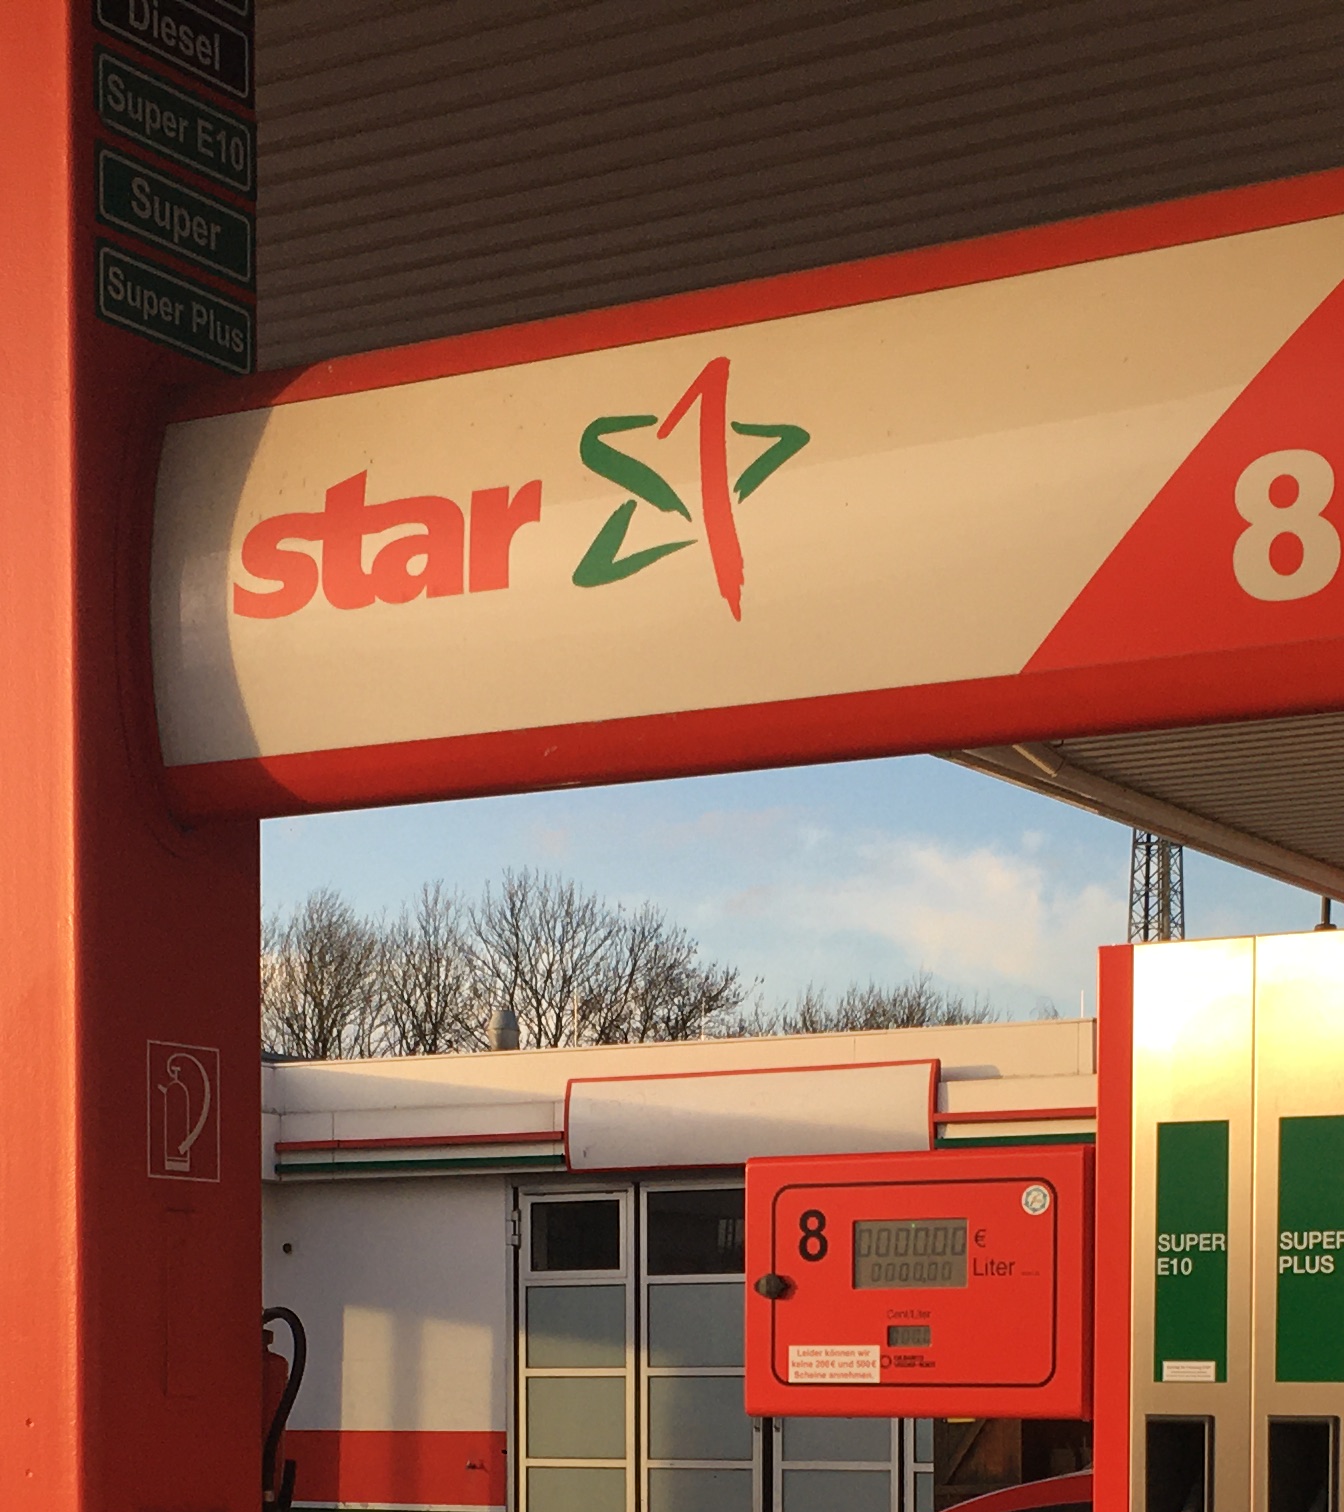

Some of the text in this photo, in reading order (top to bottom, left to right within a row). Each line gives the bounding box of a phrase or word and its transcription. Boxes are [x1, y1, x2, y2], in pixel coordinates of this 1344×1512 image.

[128, 0, 221, 70] Diesel
[107, 73, 245, 172] Super E10
[131, 176, 222, 251] Super
[108, 265, 244, 353] Super Plus
[1233, 449, 1341, 601] 8
[233, 469, 542, 618] star
[798, 1208, 828, 1262] 8
[974, 1228, 987, 1248] €
[1157, 1232, 1226, 1253] SUPER
[972, 1256, 1016, 1277] Liter
[1157, 1257, 1192, 1276] E10
[1279, 1254, 1335, 1275] PLUS
[797, 1349, 870, 1357] Leider können wir
[791, 1360, 813, 1368] keine
[838, 1360, 854, 1368] und
[794, 1371, 826, 1379] Scheine
